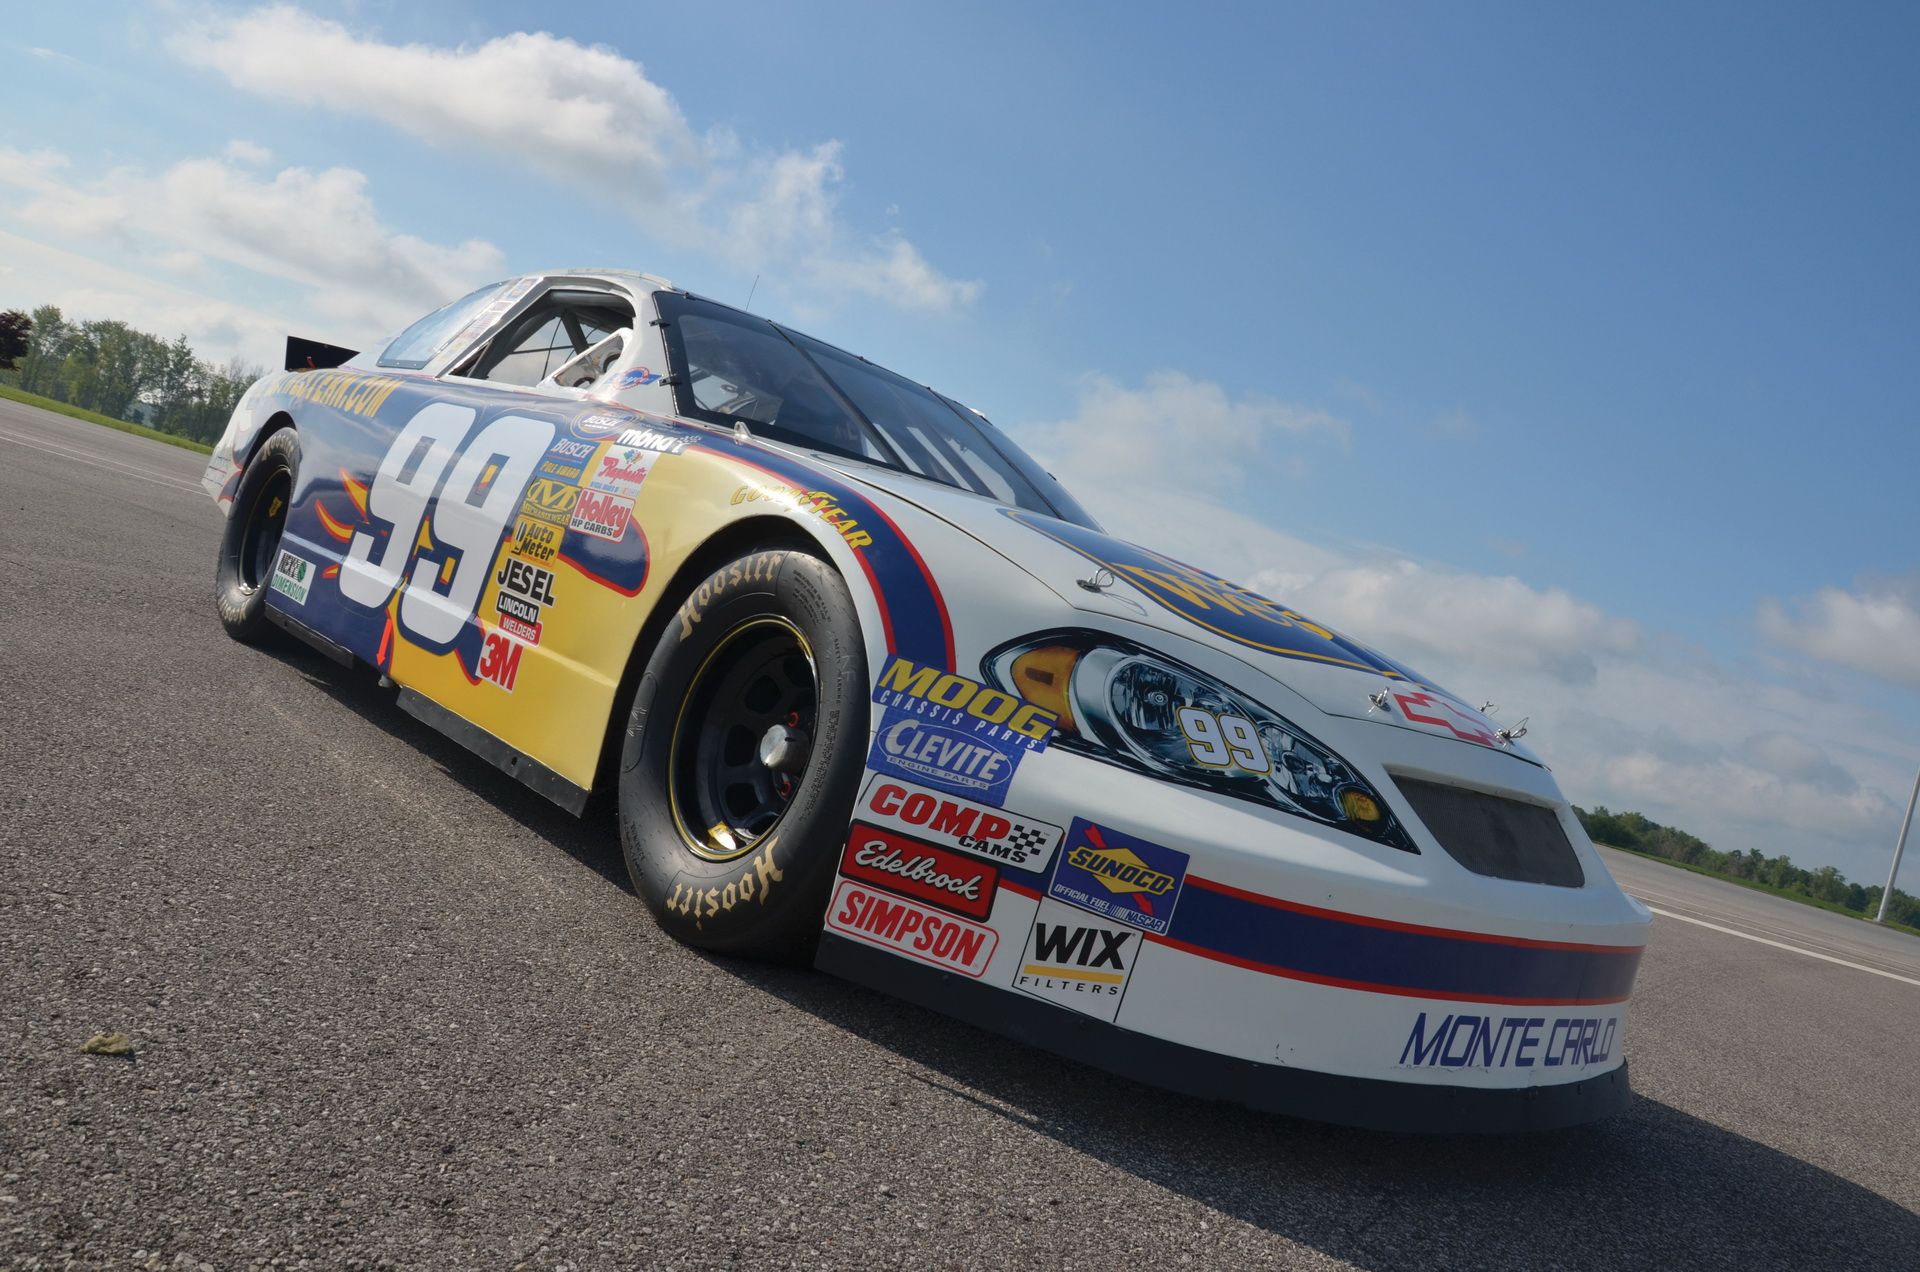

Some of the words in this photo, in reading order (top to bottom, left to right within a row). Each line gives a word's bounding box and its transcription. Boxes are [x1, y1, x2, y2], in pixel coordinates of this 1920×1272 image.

[551, 438, 597, 459] BUSCH
[338, 402, 556, 645] 99
[571, 518, 583, 528] HP
[584, 521, 613, 537] CARBS
[574, 491, 631, 538] Holley
[520, 539, 554, 562] Meter
[271, 574, 307, 603] DIMENSION
[497, 558, 555, 607] JESEL
[498, 595, 537, 623] LINCOLN
[502, 616, 537, 641] WELDERS
[479, 632, 524, 691] 3M
[879, 658, 1053, 742] MOOG
[880, 689, 962, 726] CHASSIS
[975, 719, 1038, 750] PARTS
[883, 719, 1008, 782] CLEVITE
[1177, 706, 1272, 776] 99
[888, 756, 939, 774] ENGINE
[943, 770, 989, 791] PARTS
[869, 783, 1012, 844] COMP
[855, 840, 982, 901] Edelbrock
[959, 835, 1029, 864] CAMS
[1069, 849, 1175, 894] SUNOCO
[838, 890, 987, 968] SIMPSON
[1054, 884, 1089, 907] OFFICIAL
[1089, 897, 1111, 913] FUEL
[1124, 909, 1165, 931] NASCAR
[1034, 922, 1132, 971] WIX
[1019, 976, 1120, 996] FILTERS
[1399, 1012, 1546, 1067] MONTE
[1543, 1017, 1617, 1067] CARLO
